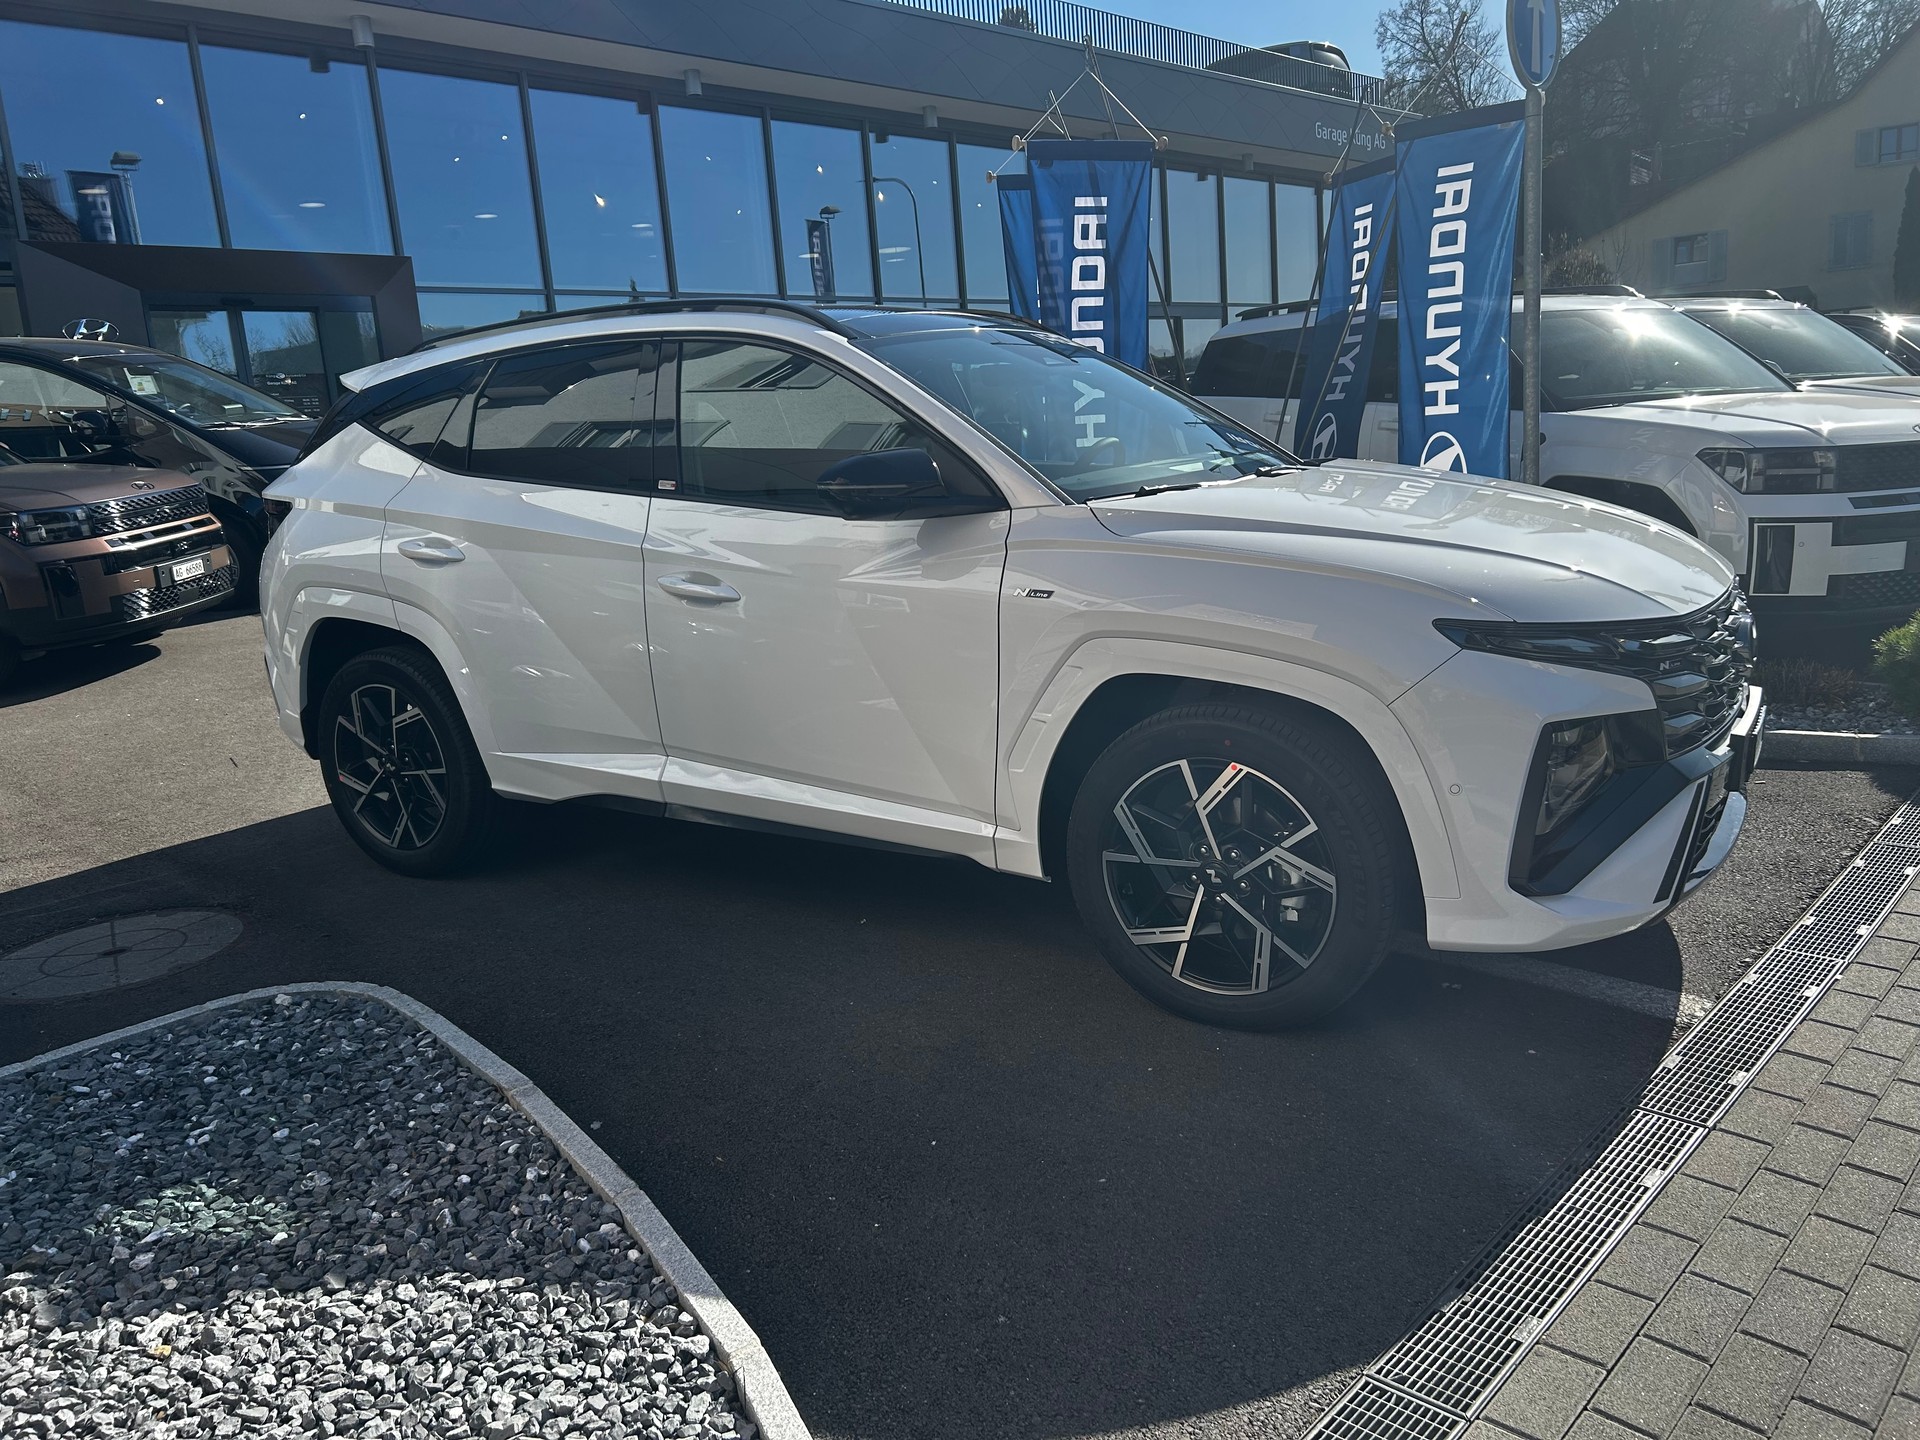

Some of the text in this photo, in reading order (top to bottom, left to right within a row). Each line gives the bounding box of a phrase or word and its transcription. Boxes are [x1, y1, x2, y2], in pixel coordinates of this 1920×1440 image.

[1315, 122, 1348, 146] Garage
[1373, 133, 1386, 150] AG
[175, 567, 183, 578] AG
[1013, 587, 1031, 598] N
